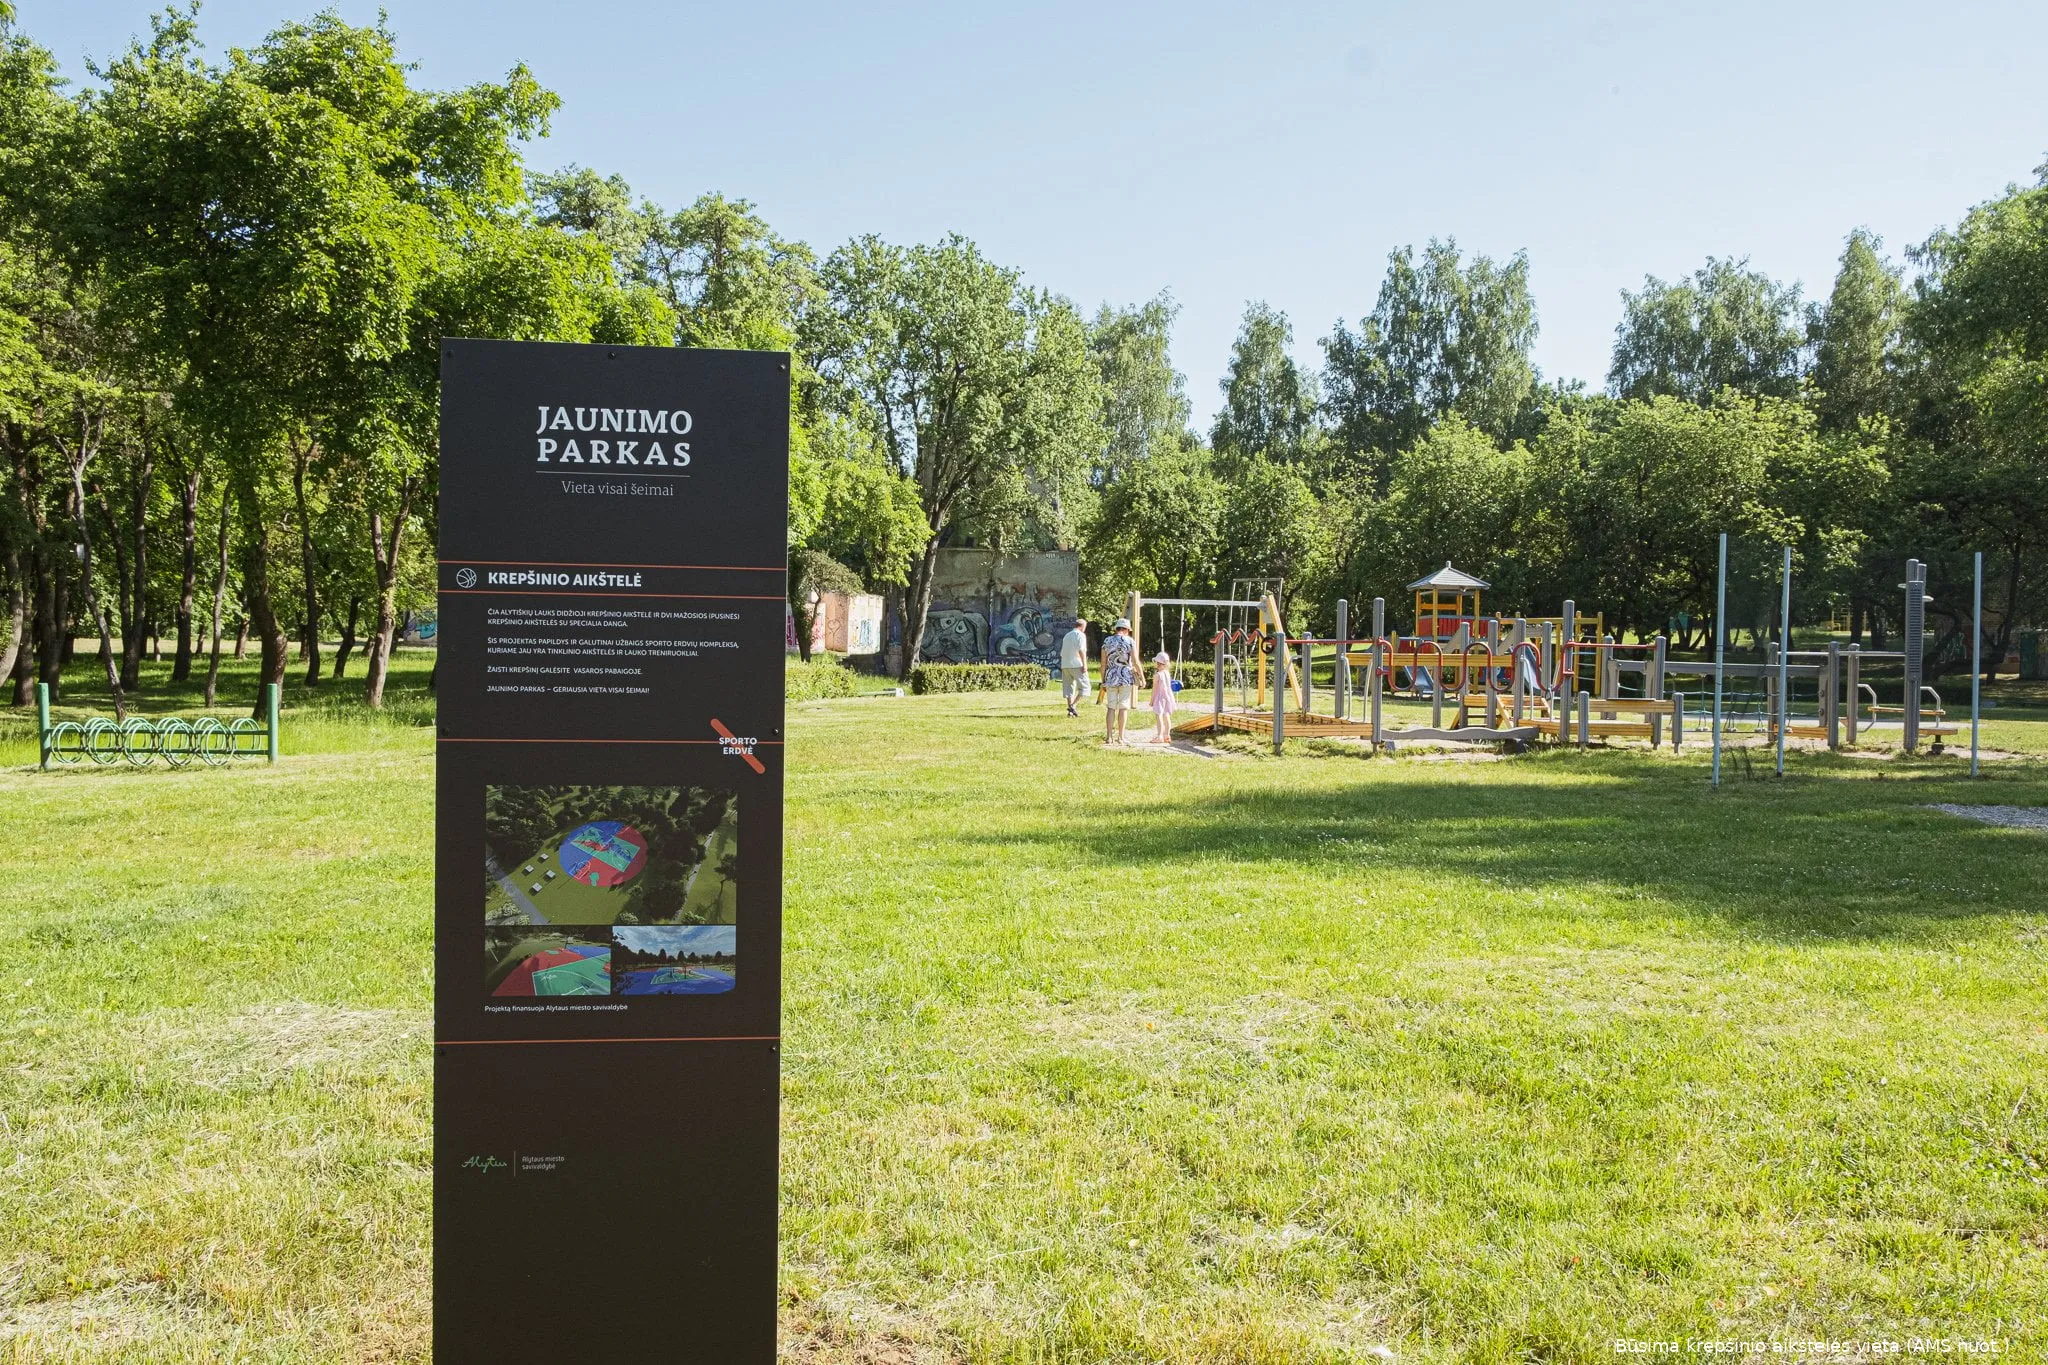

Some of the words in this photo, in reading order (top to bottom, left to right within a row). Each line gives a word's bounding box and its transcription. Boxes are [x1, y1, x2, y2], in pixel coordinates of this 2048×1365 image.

[536, 406, 693, 435] JAUNIMO
[537, 438, 691, 467] PARKAS
[561, 481, 595, 494] Vieta
[598, 482, 627, 494] visai
[630, 483, 674, 496] šeimai
[488, 570, 569, 586] KREPŠINIO
[572, 571, 642, 587] AIKŠTELĖ
[557, 609, 586, 617] DIDŽIOJI
[587, 610, 622, 618] KREPŠINIO
[673, 611, 707, 619] MAŽOSIOS
[488, 636, 498, 644] ŠIS
[499, 637, 537, 645] PROJEKTAS
[674, 640, 698, 648] ERDVIŲ
[626, 686, 650, 694] ŠEIMAI!
[719, 737, 758, 745] SPORTO
[723, 746, 753, 755] ERDVĖ
[484, 1005, 510, 1013] Projektą
